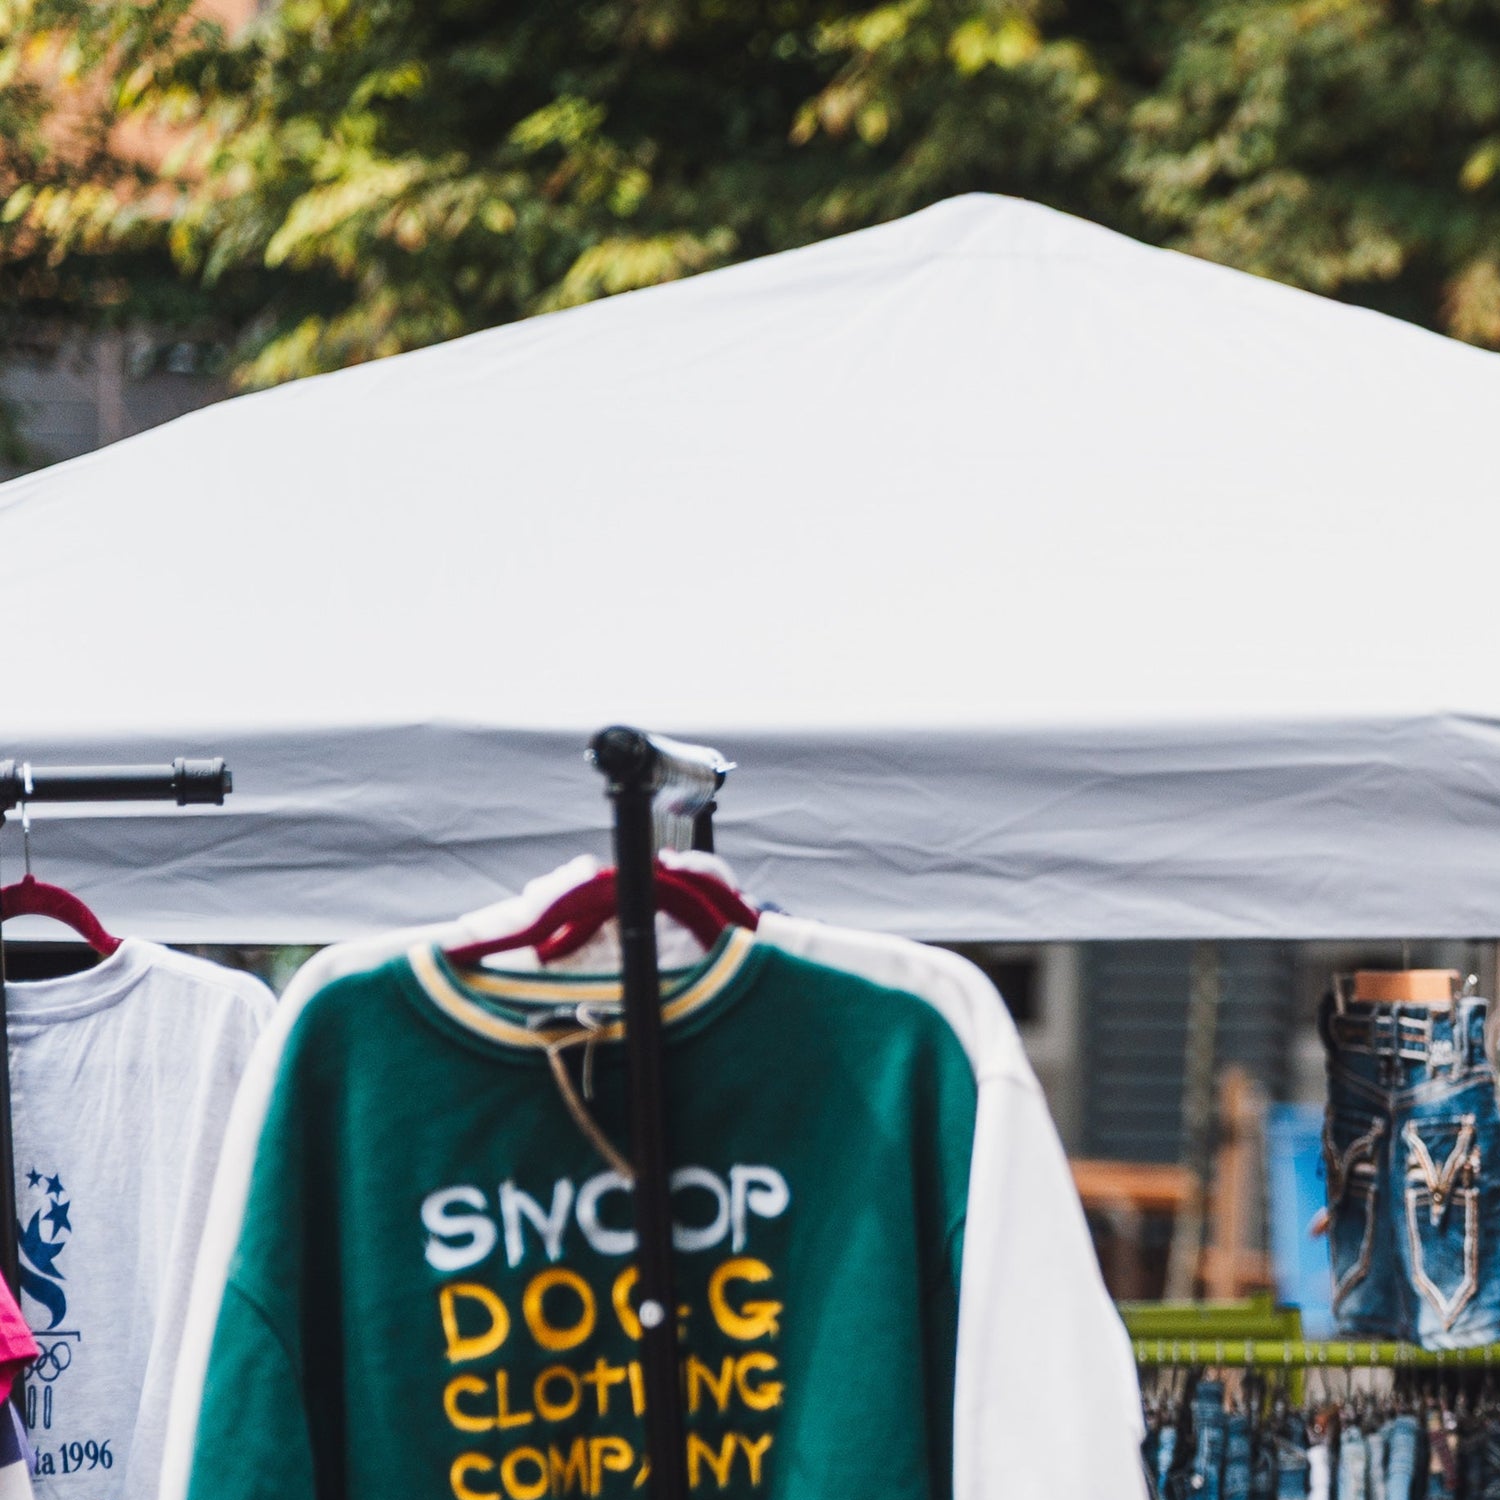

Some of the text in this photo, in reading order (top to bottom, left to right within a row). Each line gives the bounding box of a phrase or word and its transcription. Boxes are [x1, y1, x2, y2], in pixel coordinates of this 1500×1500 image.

[420, 1163, 791, 1271] SNOOP
[442, 1350, 785, 1433] CLOTNG
[58, 1439, 114, 1475] 1996
